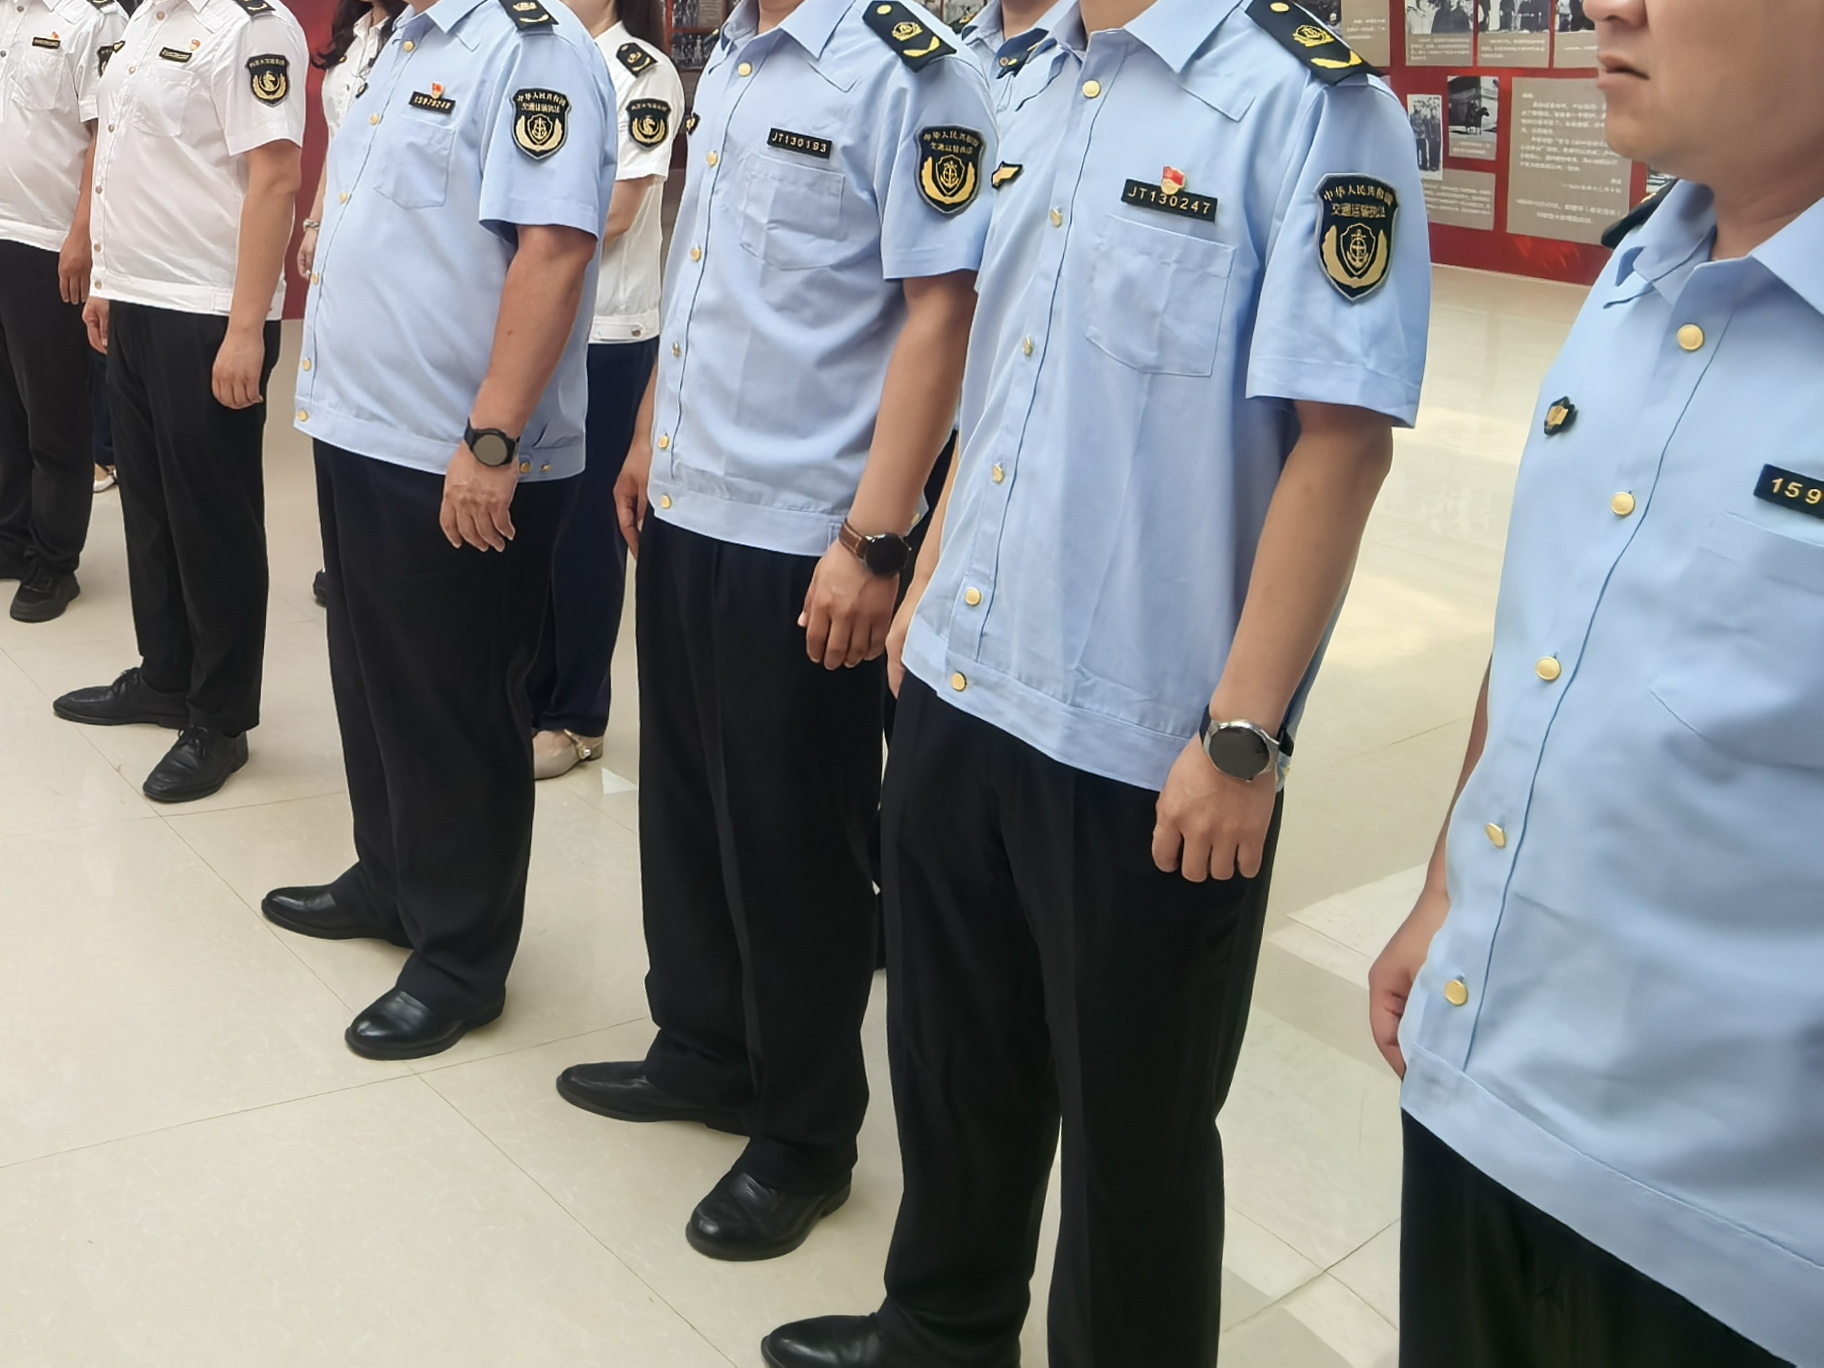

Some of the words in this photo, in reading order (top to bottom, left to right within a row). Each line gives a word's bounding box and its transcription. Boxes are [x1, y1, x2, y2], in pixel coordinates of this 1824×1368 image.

[771, 132, 827, 153] JT130193
[1127, 186, 1211, 214] JT130247
[1772, 478, 1822, 505] 159
